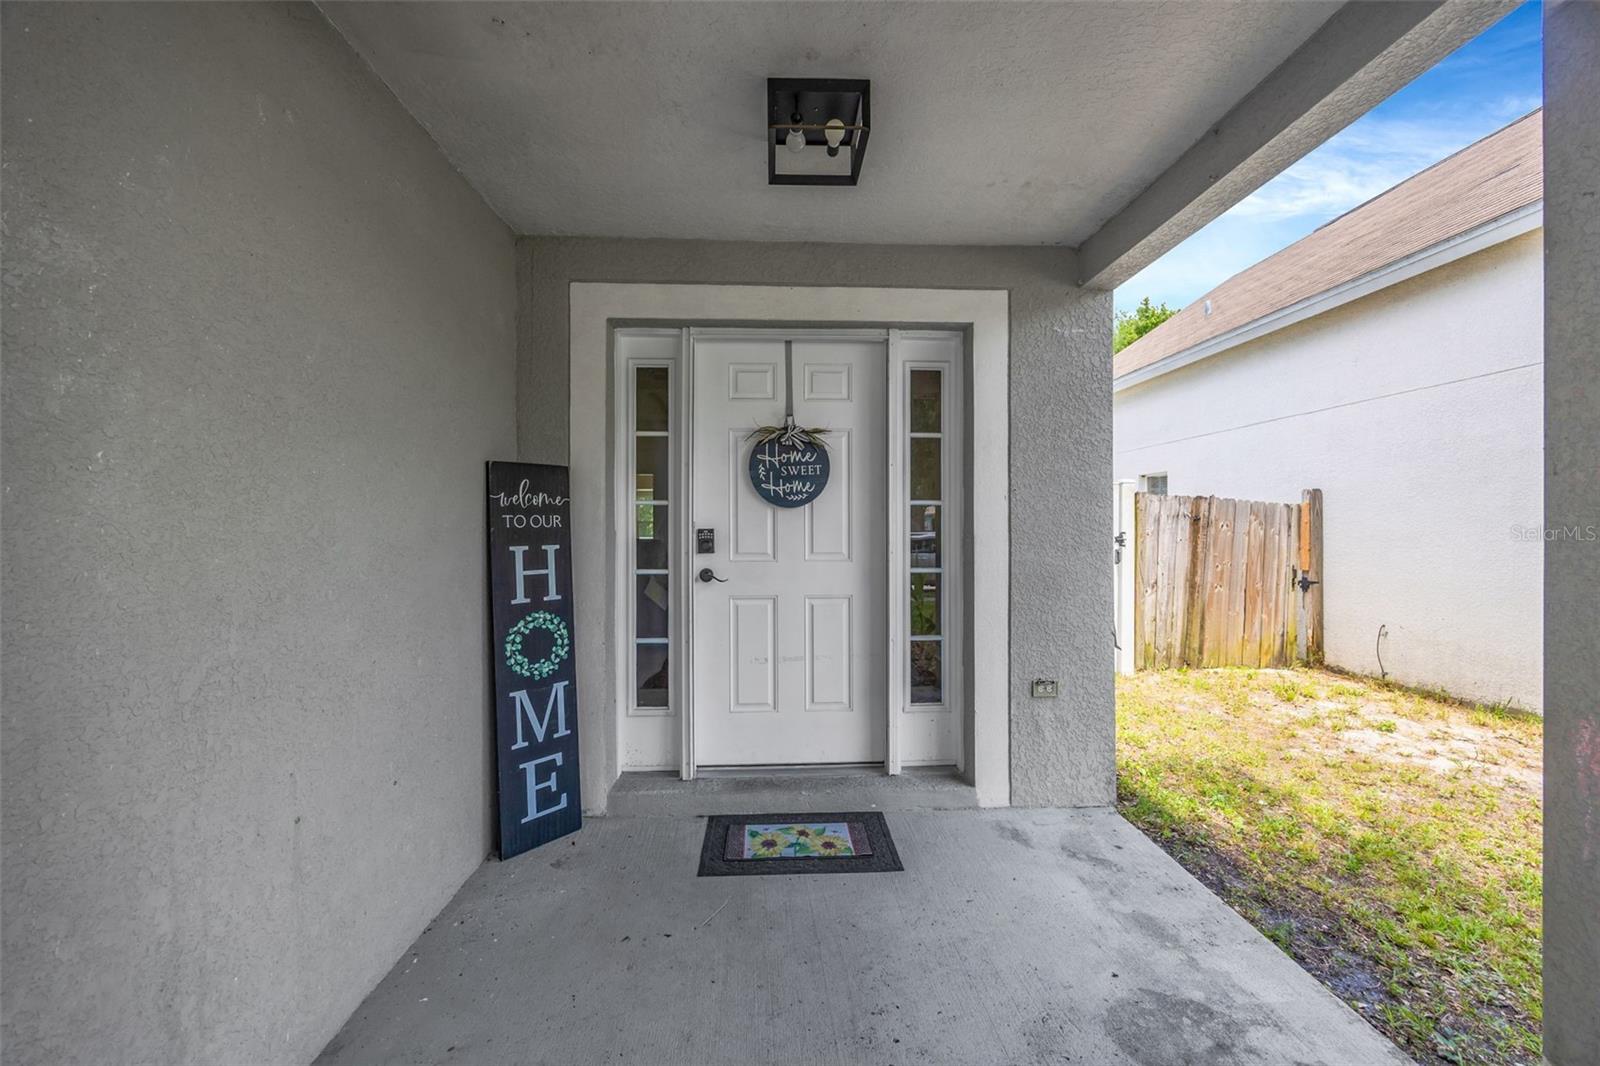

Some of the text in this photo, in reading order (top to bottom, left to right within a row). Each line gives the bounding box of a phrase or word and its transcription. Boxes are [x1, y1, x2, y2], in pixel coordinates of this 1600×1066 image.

[756, 442, 818, 469] Home
[781, 464, 822, 476] SWEET
[490, 478, 570, 509] welcome
[761, 471, 816, 498] Home
[502, 515, 562, 528] TO OUR
